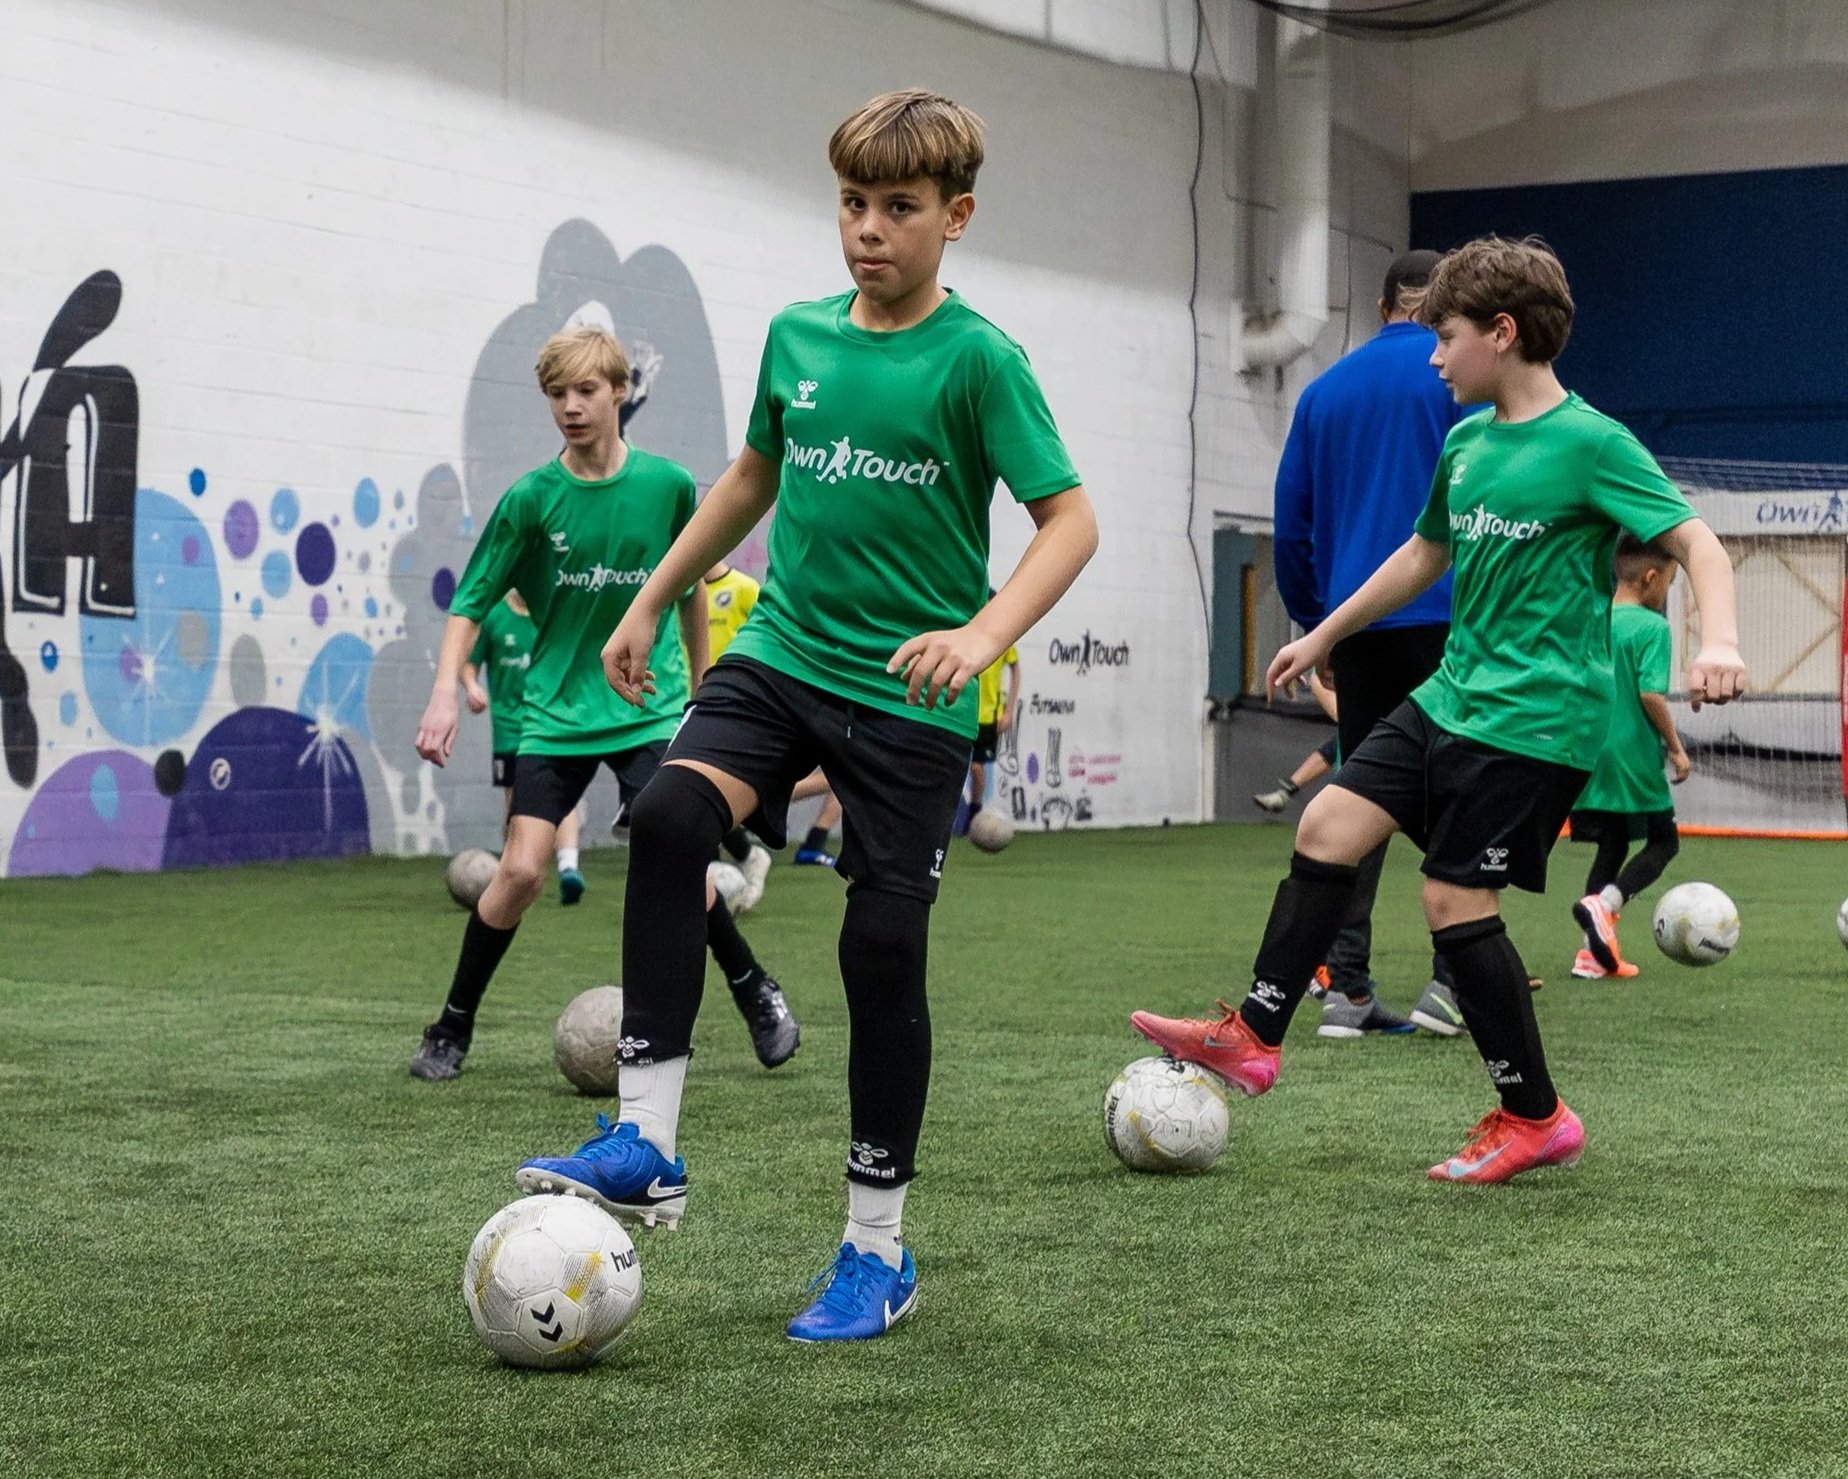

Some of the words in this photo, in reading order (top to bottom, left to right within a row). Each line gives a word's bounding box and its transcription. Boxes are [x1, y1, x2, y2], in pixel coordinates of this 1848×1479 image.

[851, 449, 941, 486] Touch
[1049, 638, 1080, 665] Own
[1091, 640, 1129, 667] Touch
